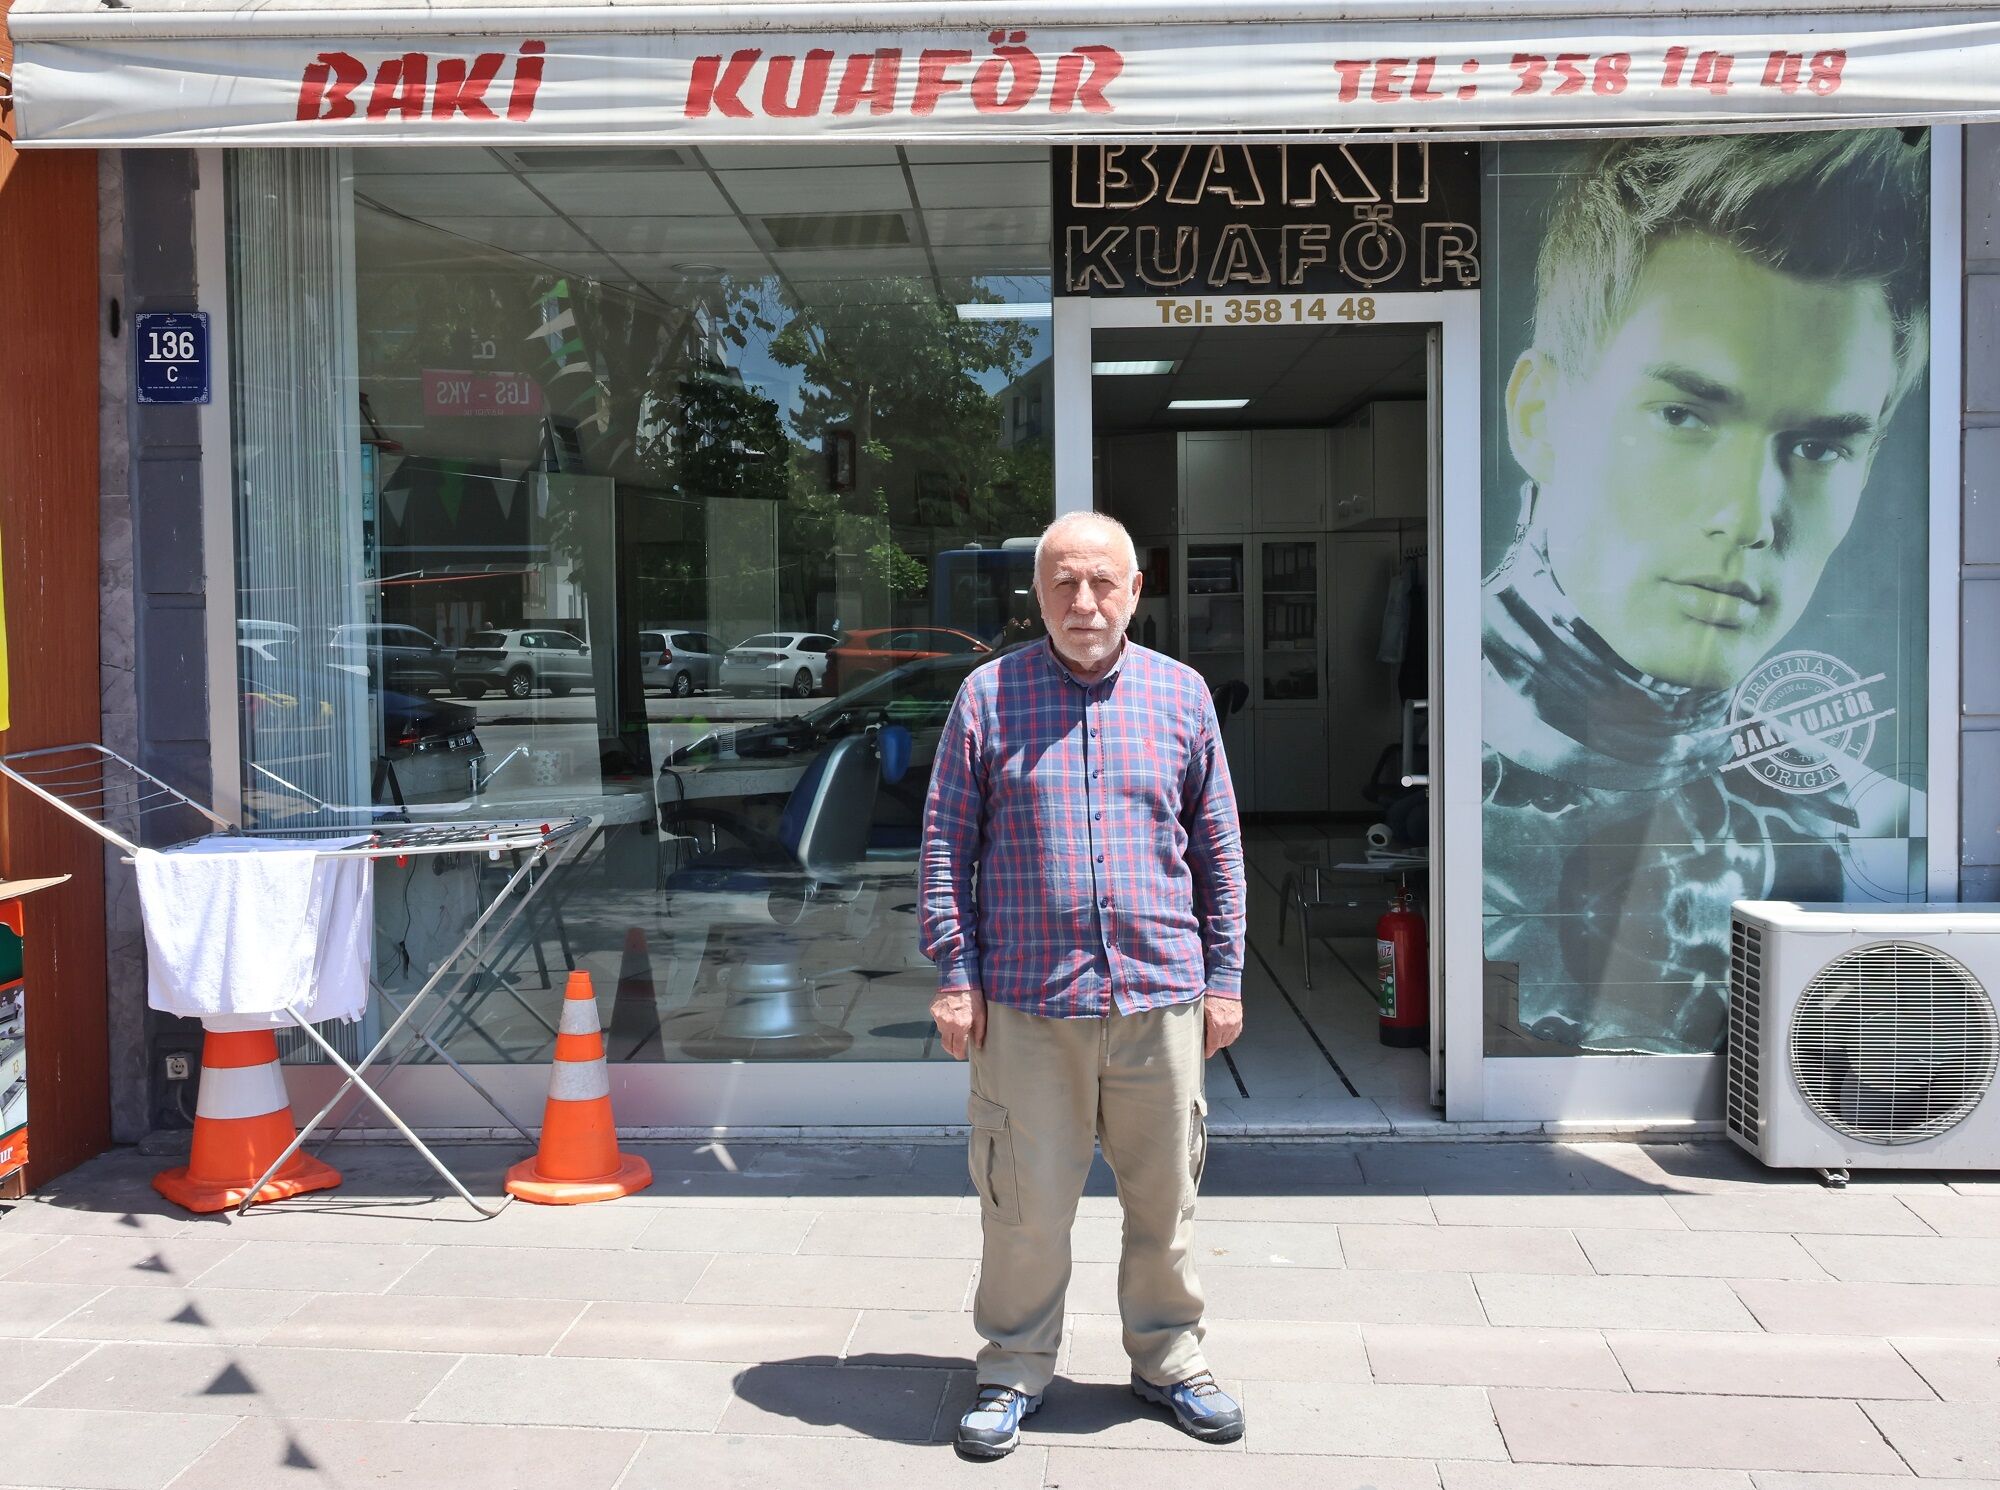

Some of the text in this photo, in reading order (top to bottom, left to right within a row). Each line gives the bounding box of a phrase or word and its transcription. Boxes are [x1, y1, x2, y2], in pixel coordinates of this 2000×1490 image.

[298, 31, 1123, 121] BAKİ KUAFÖR
[1334, 46, 1847, 103] TEL: 358 14 48
[1065, 205, 1481, 291] KUAFÖR
[1156, 297, 1376, 323] Tel: 358 14 48
[148, 331, 195, 359] 136
[167, 366, 178, 383] C
[1740, 657, 1839, 711] ORIGINAL
